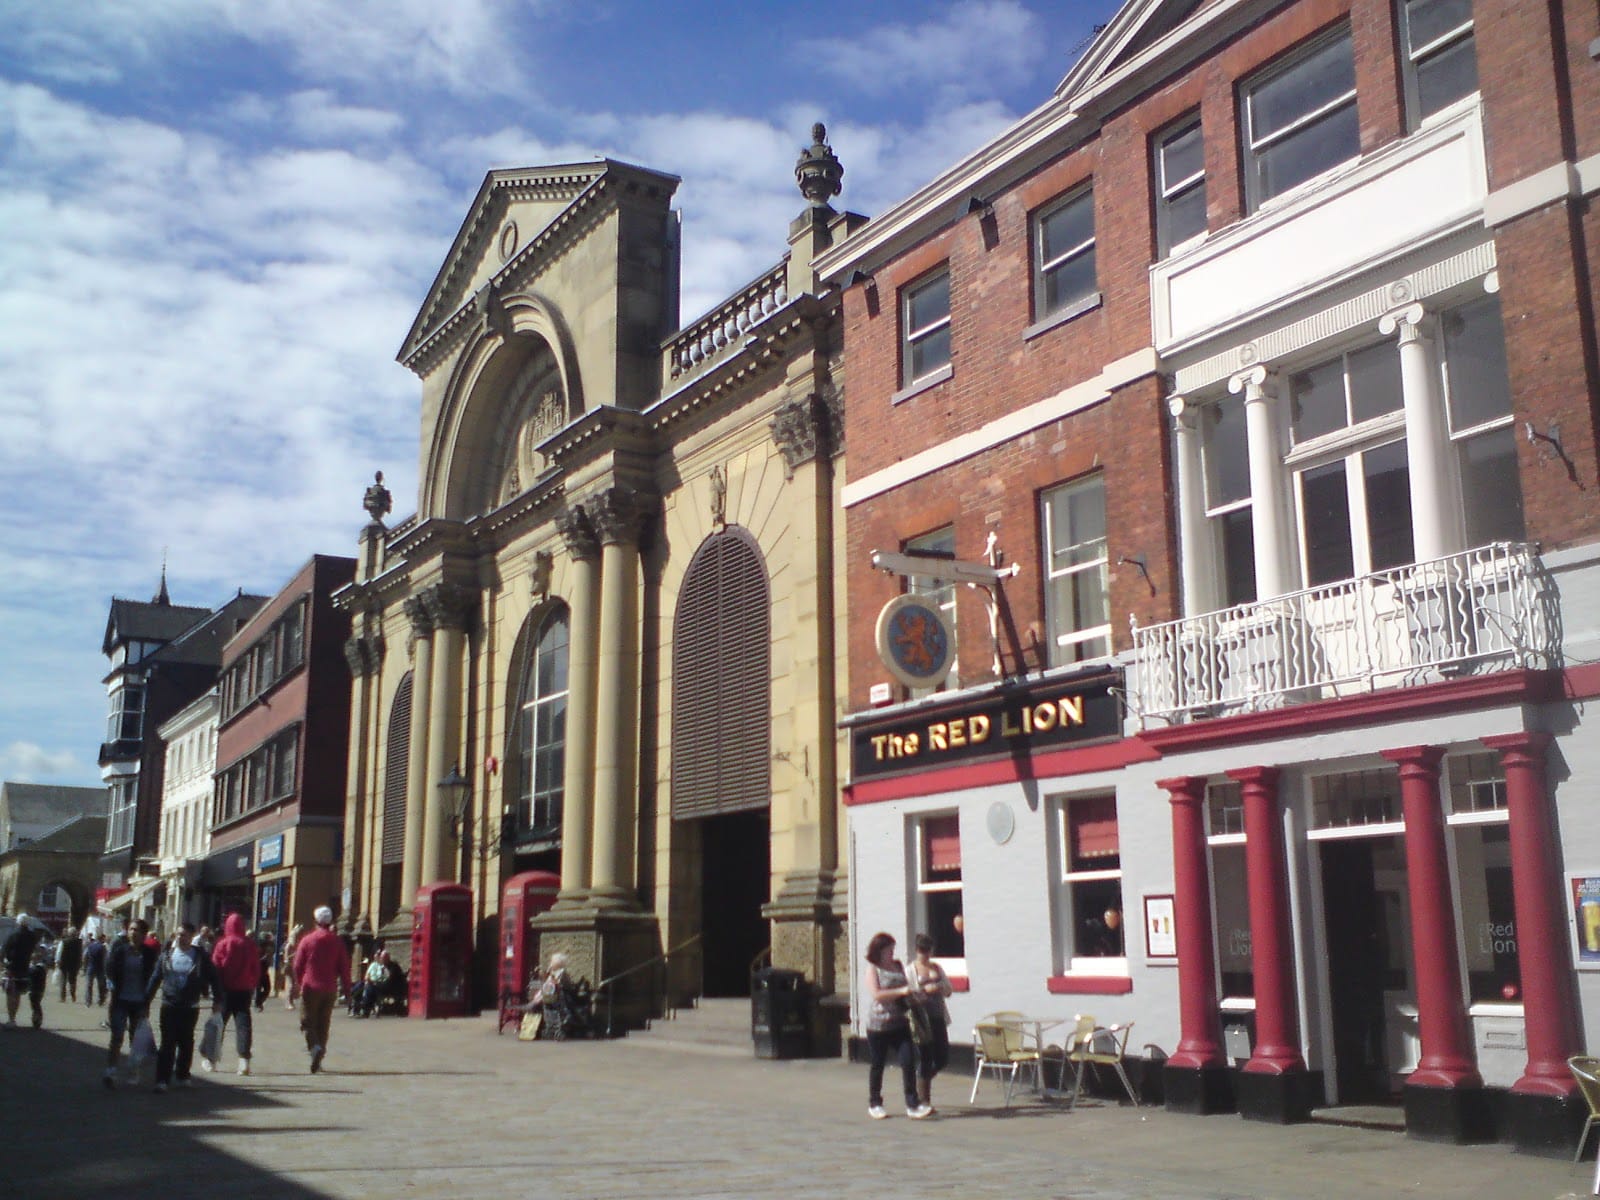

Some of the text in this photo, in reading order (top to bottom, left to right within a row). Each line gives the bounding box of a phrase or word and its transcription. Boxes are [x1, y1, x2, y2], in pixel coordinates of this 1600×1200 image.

[871, 695, 1083, 760] The RED LION
[1487, 922, 1514, 937] Red
[1480, 938, 1516, 953] Lion
